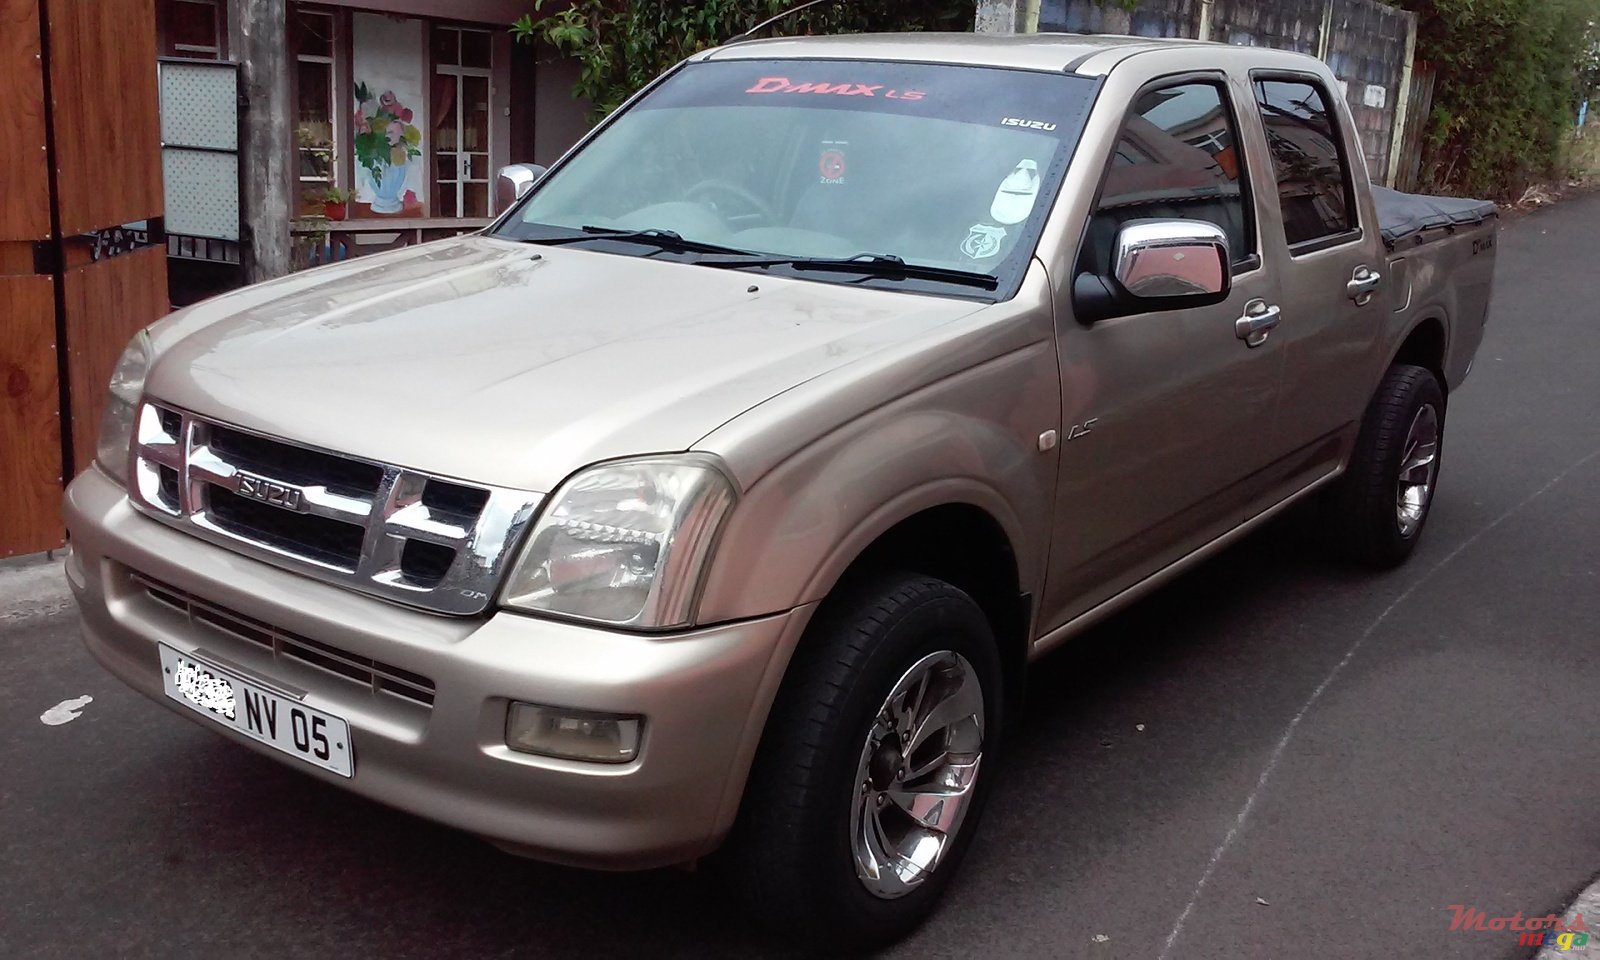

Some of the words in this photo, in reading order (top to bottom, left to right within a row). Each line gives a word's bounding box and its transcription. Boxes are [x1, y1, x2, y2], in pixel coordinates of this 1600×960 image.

[885, 90, 926, 100] LS
[1000, 117, 1057, 131] ISUZU
[820, 176, 845, 184] ZONE
[235, 472, 302, 510] ISUZU
[244, 688, 277, 740] NV
[290, 707, 330, 761] 05
